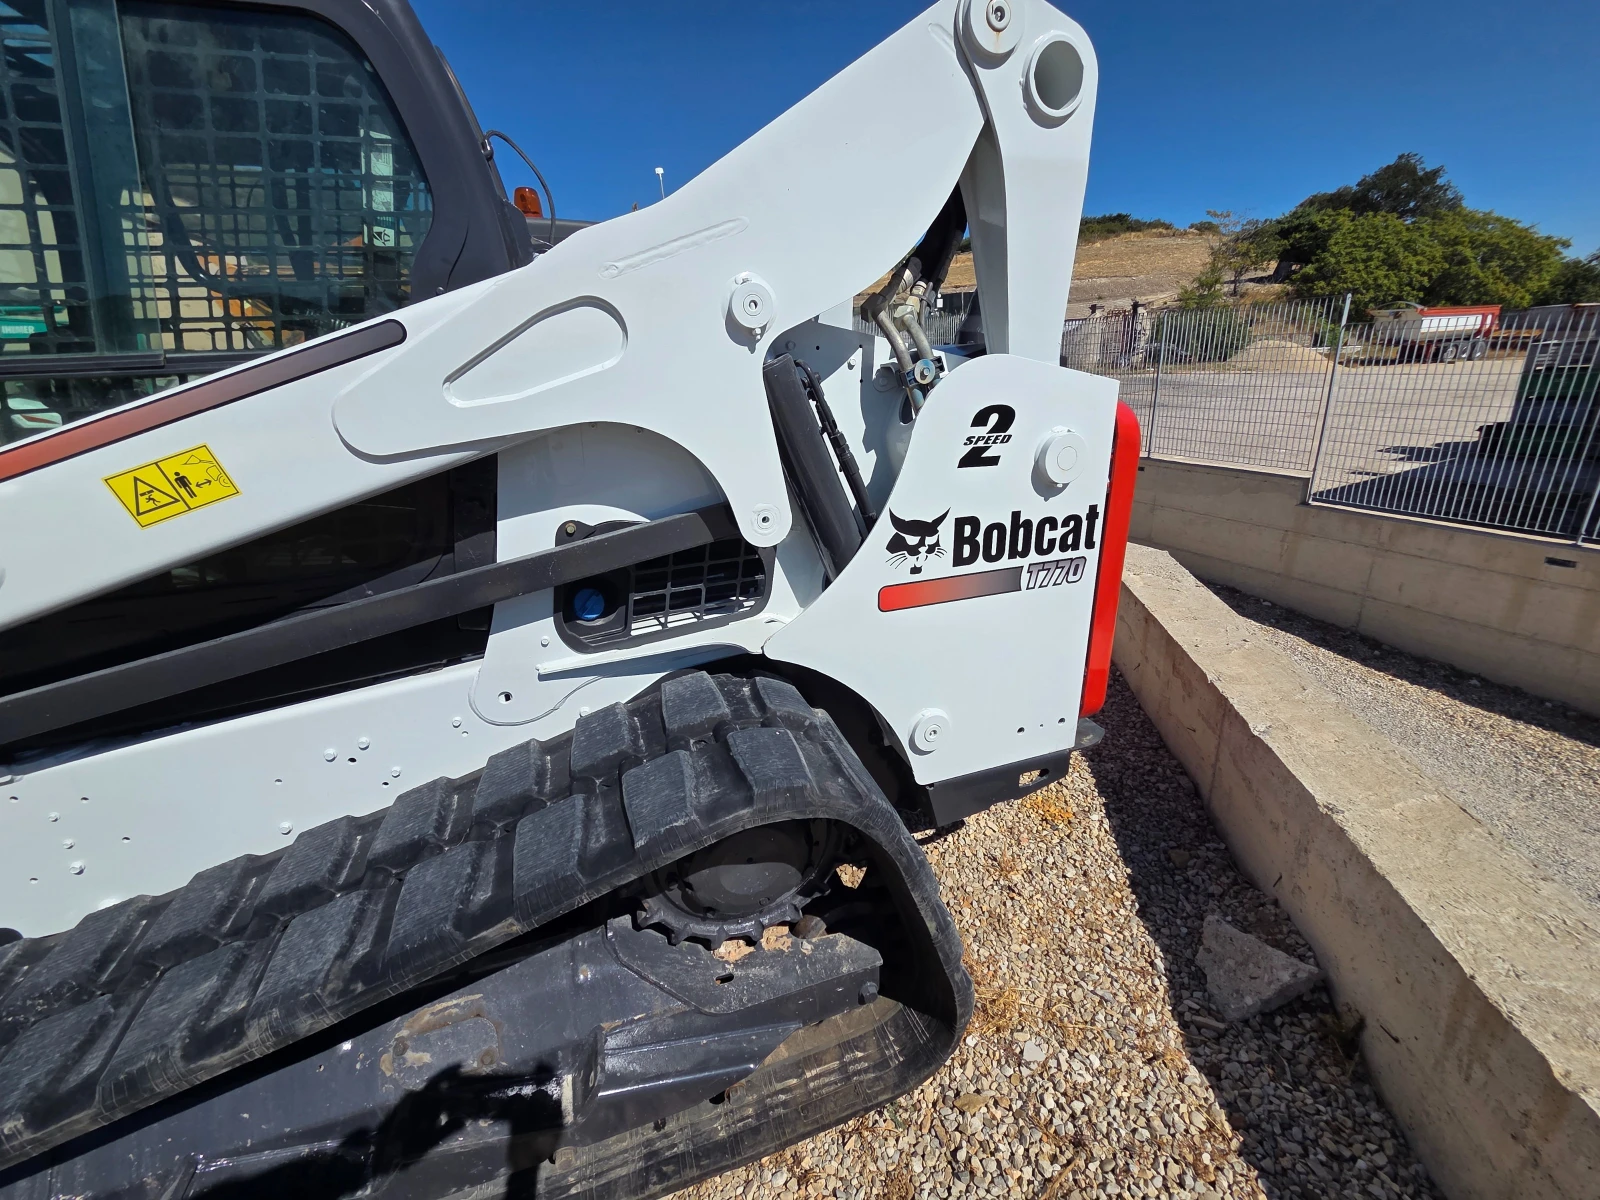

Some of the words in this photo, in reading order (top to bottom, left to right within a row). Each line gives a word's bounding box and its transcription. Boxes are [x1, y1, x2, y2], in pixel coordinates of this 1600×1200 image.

[957, 404, 1016, 468] 2
[963, 434, 1013, 446] SPEED
[952, 504, 1100, 568] Bobcat
[1026, 556, 1087, 590] T770
